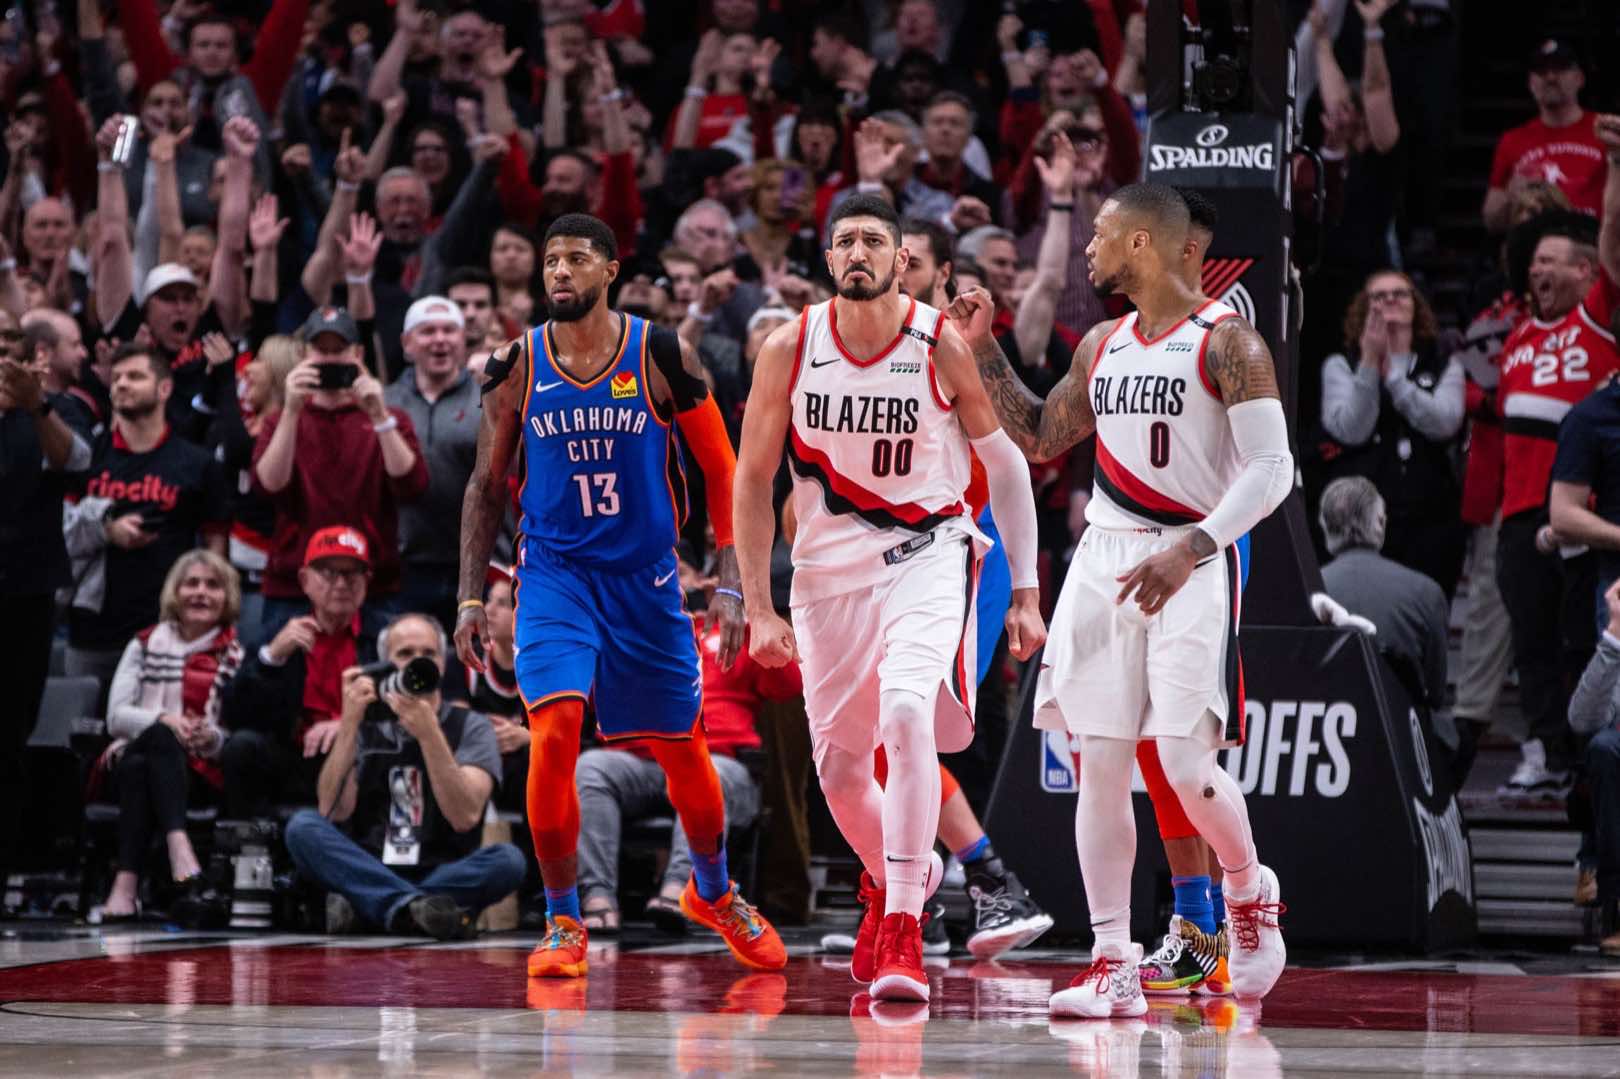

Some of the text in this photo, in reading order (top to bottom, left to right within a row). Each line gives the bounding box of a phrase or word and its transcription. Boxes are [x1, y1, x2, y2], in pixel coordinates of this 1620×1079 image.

[1149, 142, 1273, 172] SPALDING
[1532, 345, 1591, 387] 22
[804, 391, 919, 434] BLAZERS
[1094, 375, 1187, 417] BLAZERS
[530, 406, 648, 438] OKLAHOMA
[567, 438, 614, 462] CITY
[871, 437, 914, 478] 00
[1150, 421, 1170, 469] 0
[572, 472, 621, 518] 13
[1224, 701, 1358, 798] OFFS
[1048, 770, 1069, 787] NBA
